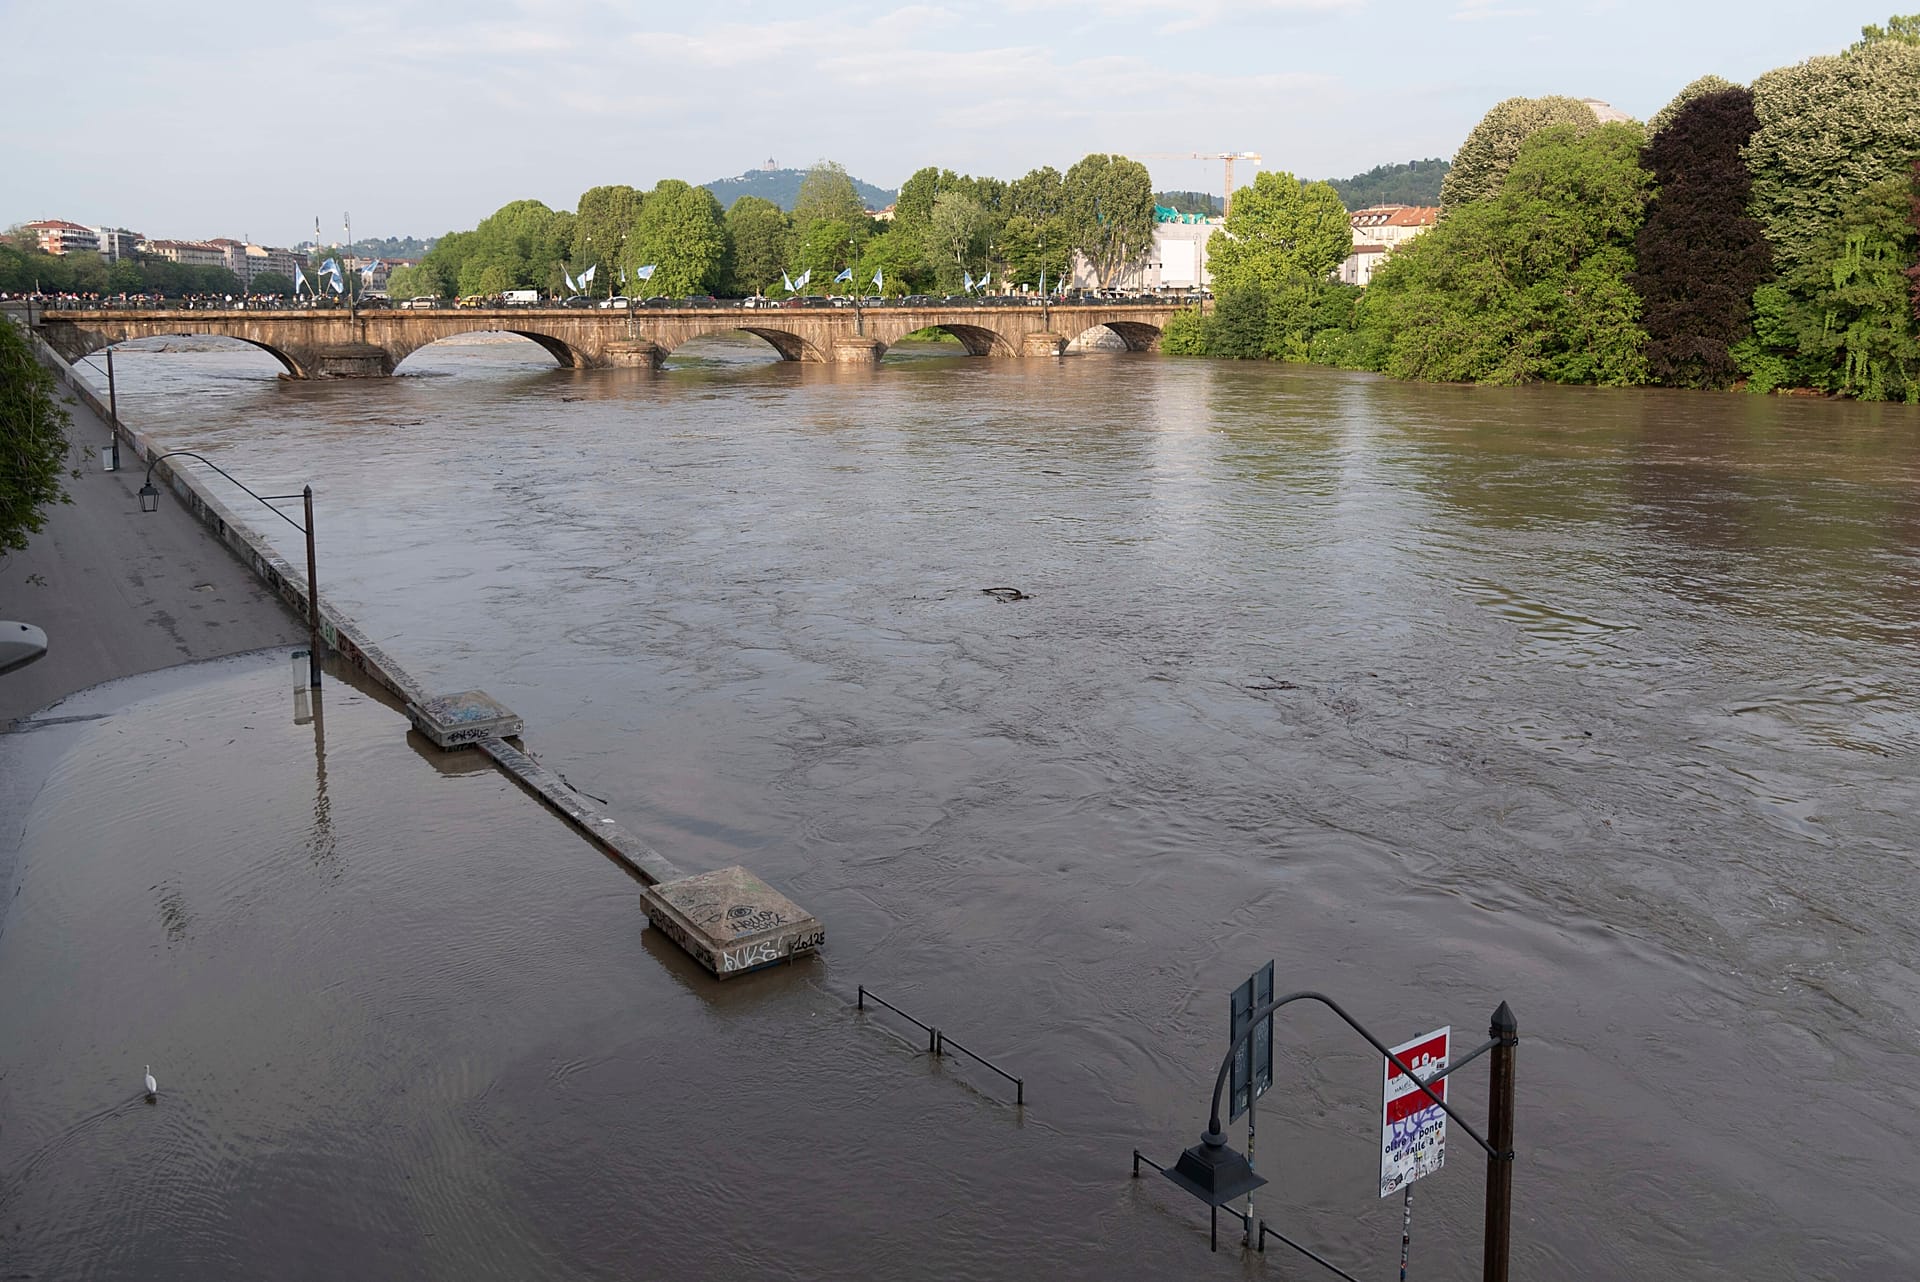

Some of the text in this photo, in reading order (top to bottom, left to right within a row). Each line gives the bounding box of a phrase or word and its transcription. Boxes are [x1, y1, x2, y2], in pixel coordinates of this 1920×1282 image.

[1385, 1137, 1407, 1153] oltre
[1419, 1120, 1443, 1140] ponte
[1393, 1150, 1402, 1163] di
[1429, 1137, 1434, 1146] a
